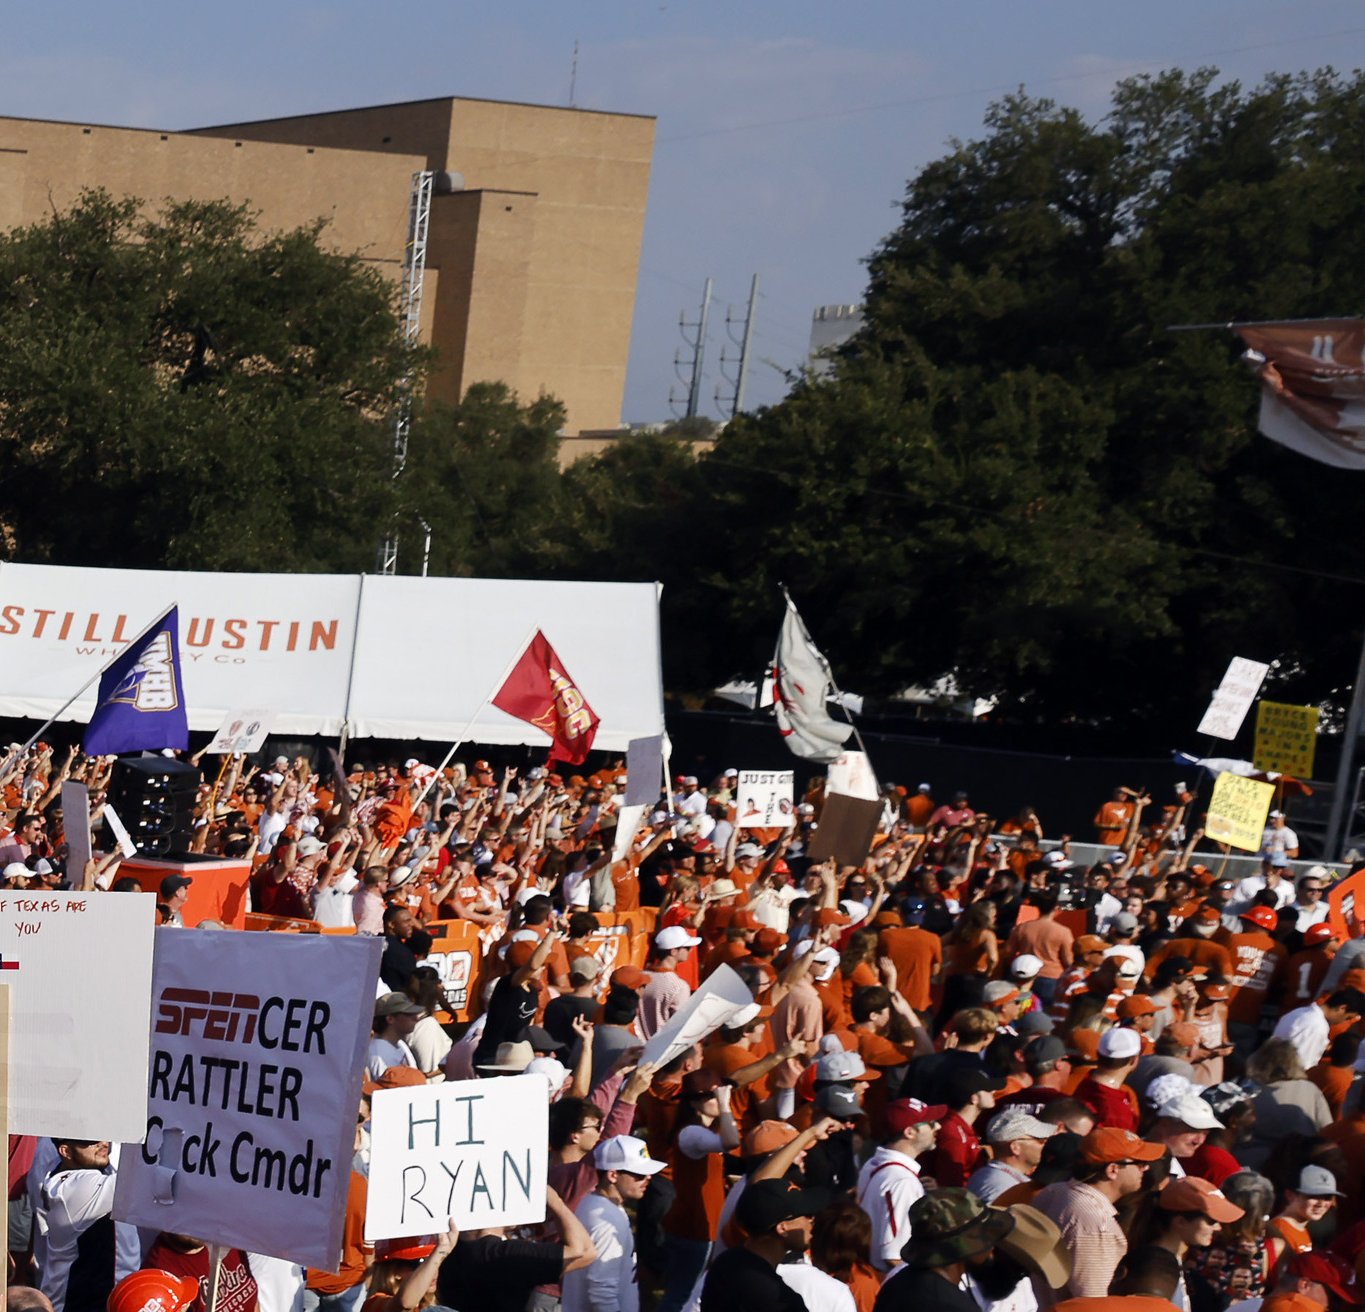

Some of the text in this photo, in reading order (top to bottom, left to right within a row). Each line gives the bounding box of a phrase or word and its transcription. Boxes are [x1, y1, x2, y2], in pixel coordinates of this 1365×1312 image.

[186, 616, 340, 654] USTIN
[13, 899, 61, 913] TEXAS
[65, 899, 88, 913] ARE
[14, 921, 43, 937] YOU
[154, 985, 331, 1055] SPENCER
[150, 1050, 304, 1121] RATTLER
[408, 1094, 486, 1150] HI
[139, 1115, 332, 1199] Cck Cmdr
[401, 1148, 531, 1224] RYAN
